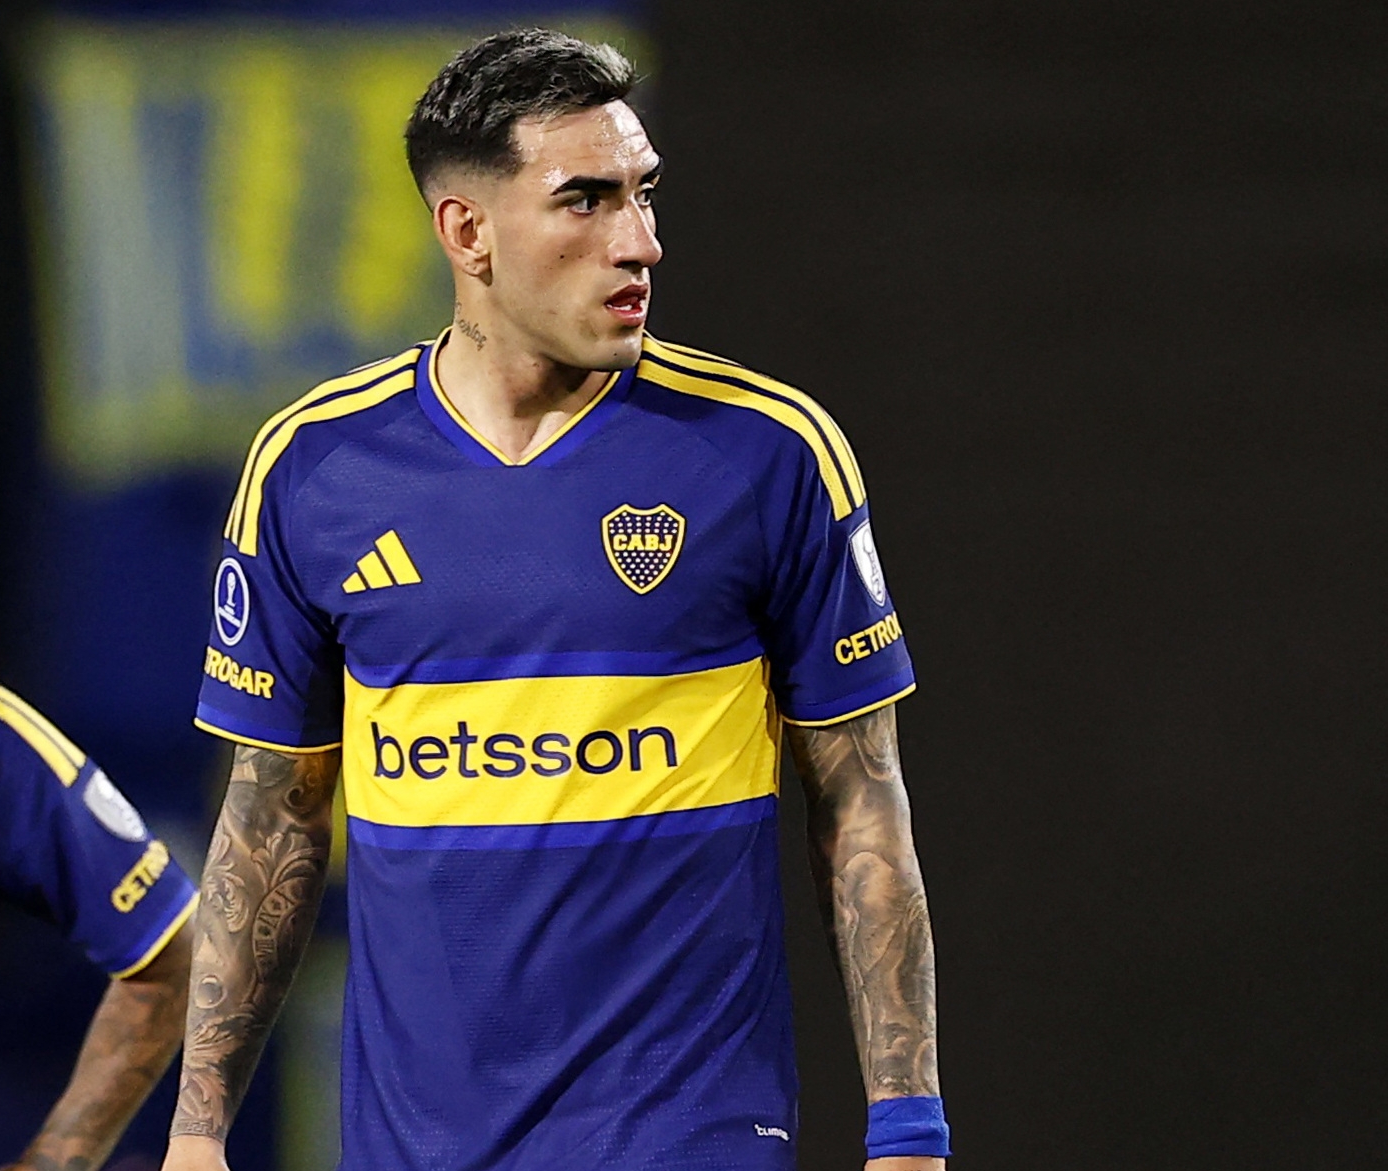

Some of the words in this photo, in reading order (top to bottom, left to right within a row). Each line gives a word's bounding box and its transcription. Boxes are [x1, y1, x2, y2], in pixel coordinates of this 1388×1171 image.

[613, 533, 673, 551] CABJ
[835, 611, 903, 665] CETRO
[371, 720, 678, 780] betsson
